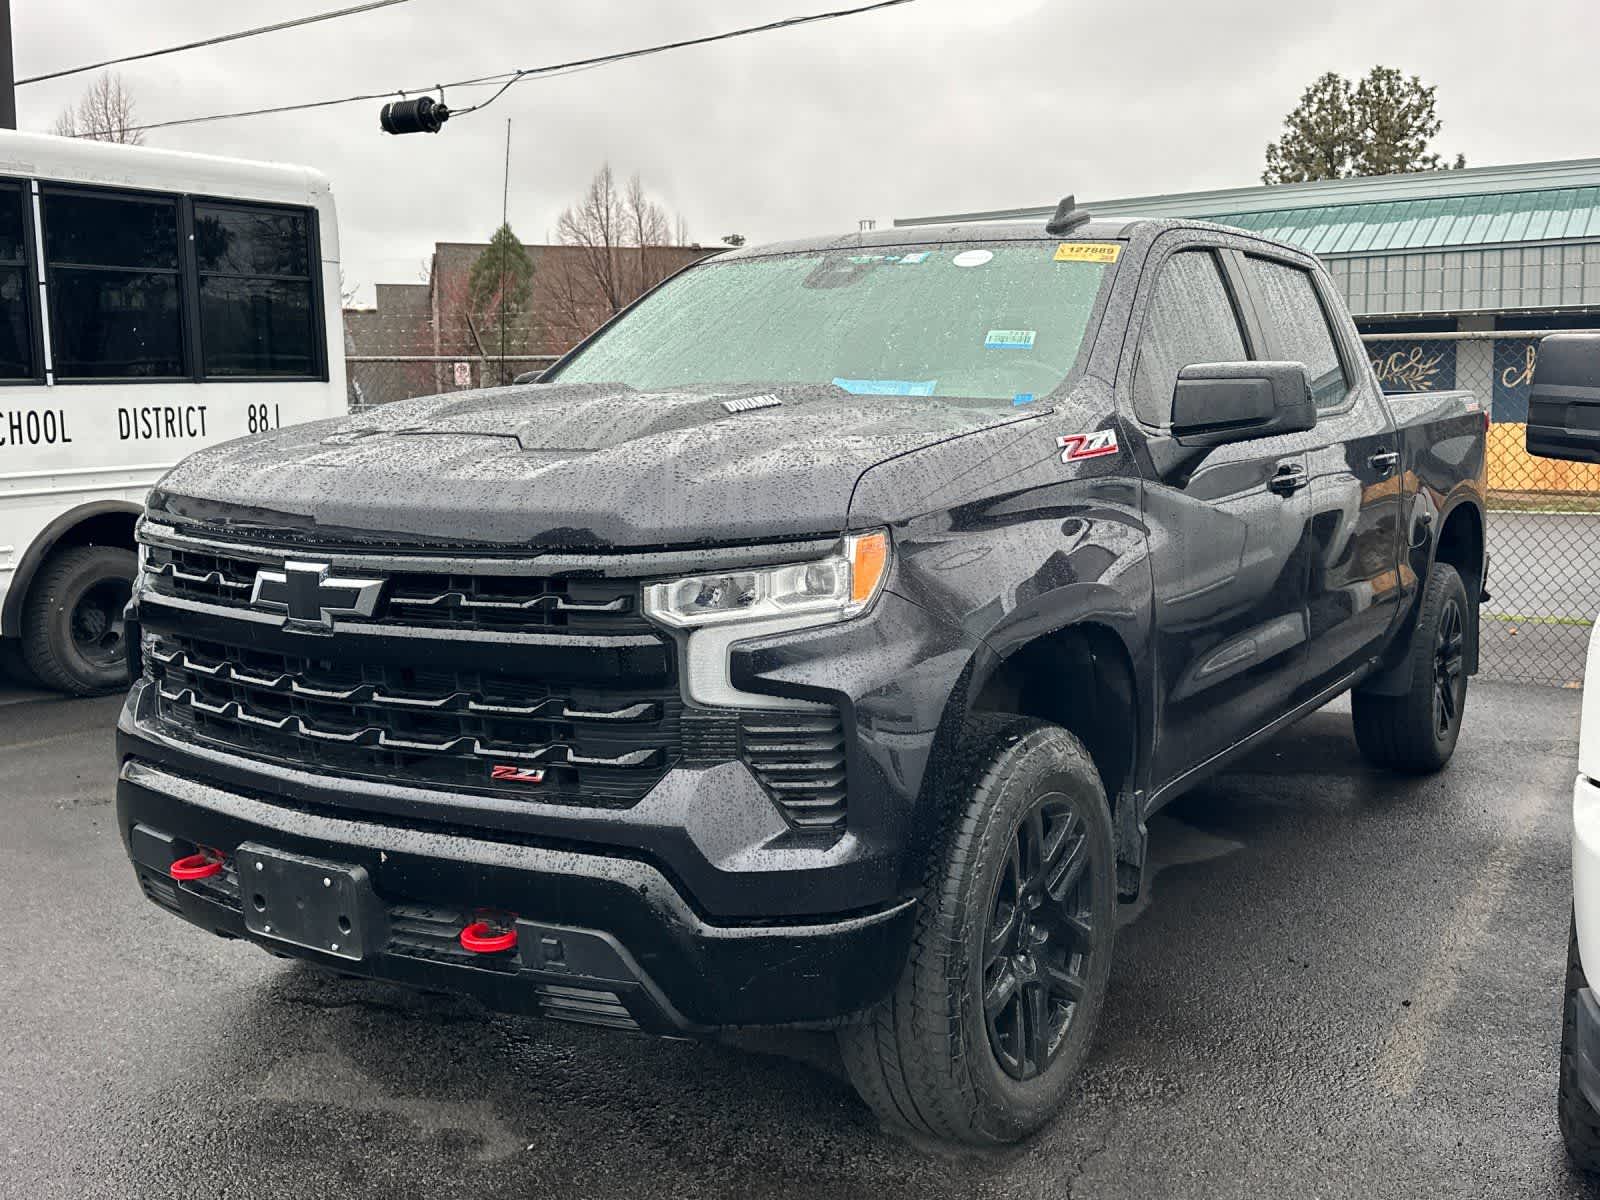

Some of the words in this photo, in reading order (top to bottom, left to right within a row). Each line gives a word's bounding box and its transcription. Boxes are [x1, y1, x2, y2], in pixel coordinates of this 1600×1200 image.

[118, 405, 206, 439] DISTRICT
[1056, 428, 1119, 463] Z71
[491, 765, 545, 782] Z71
